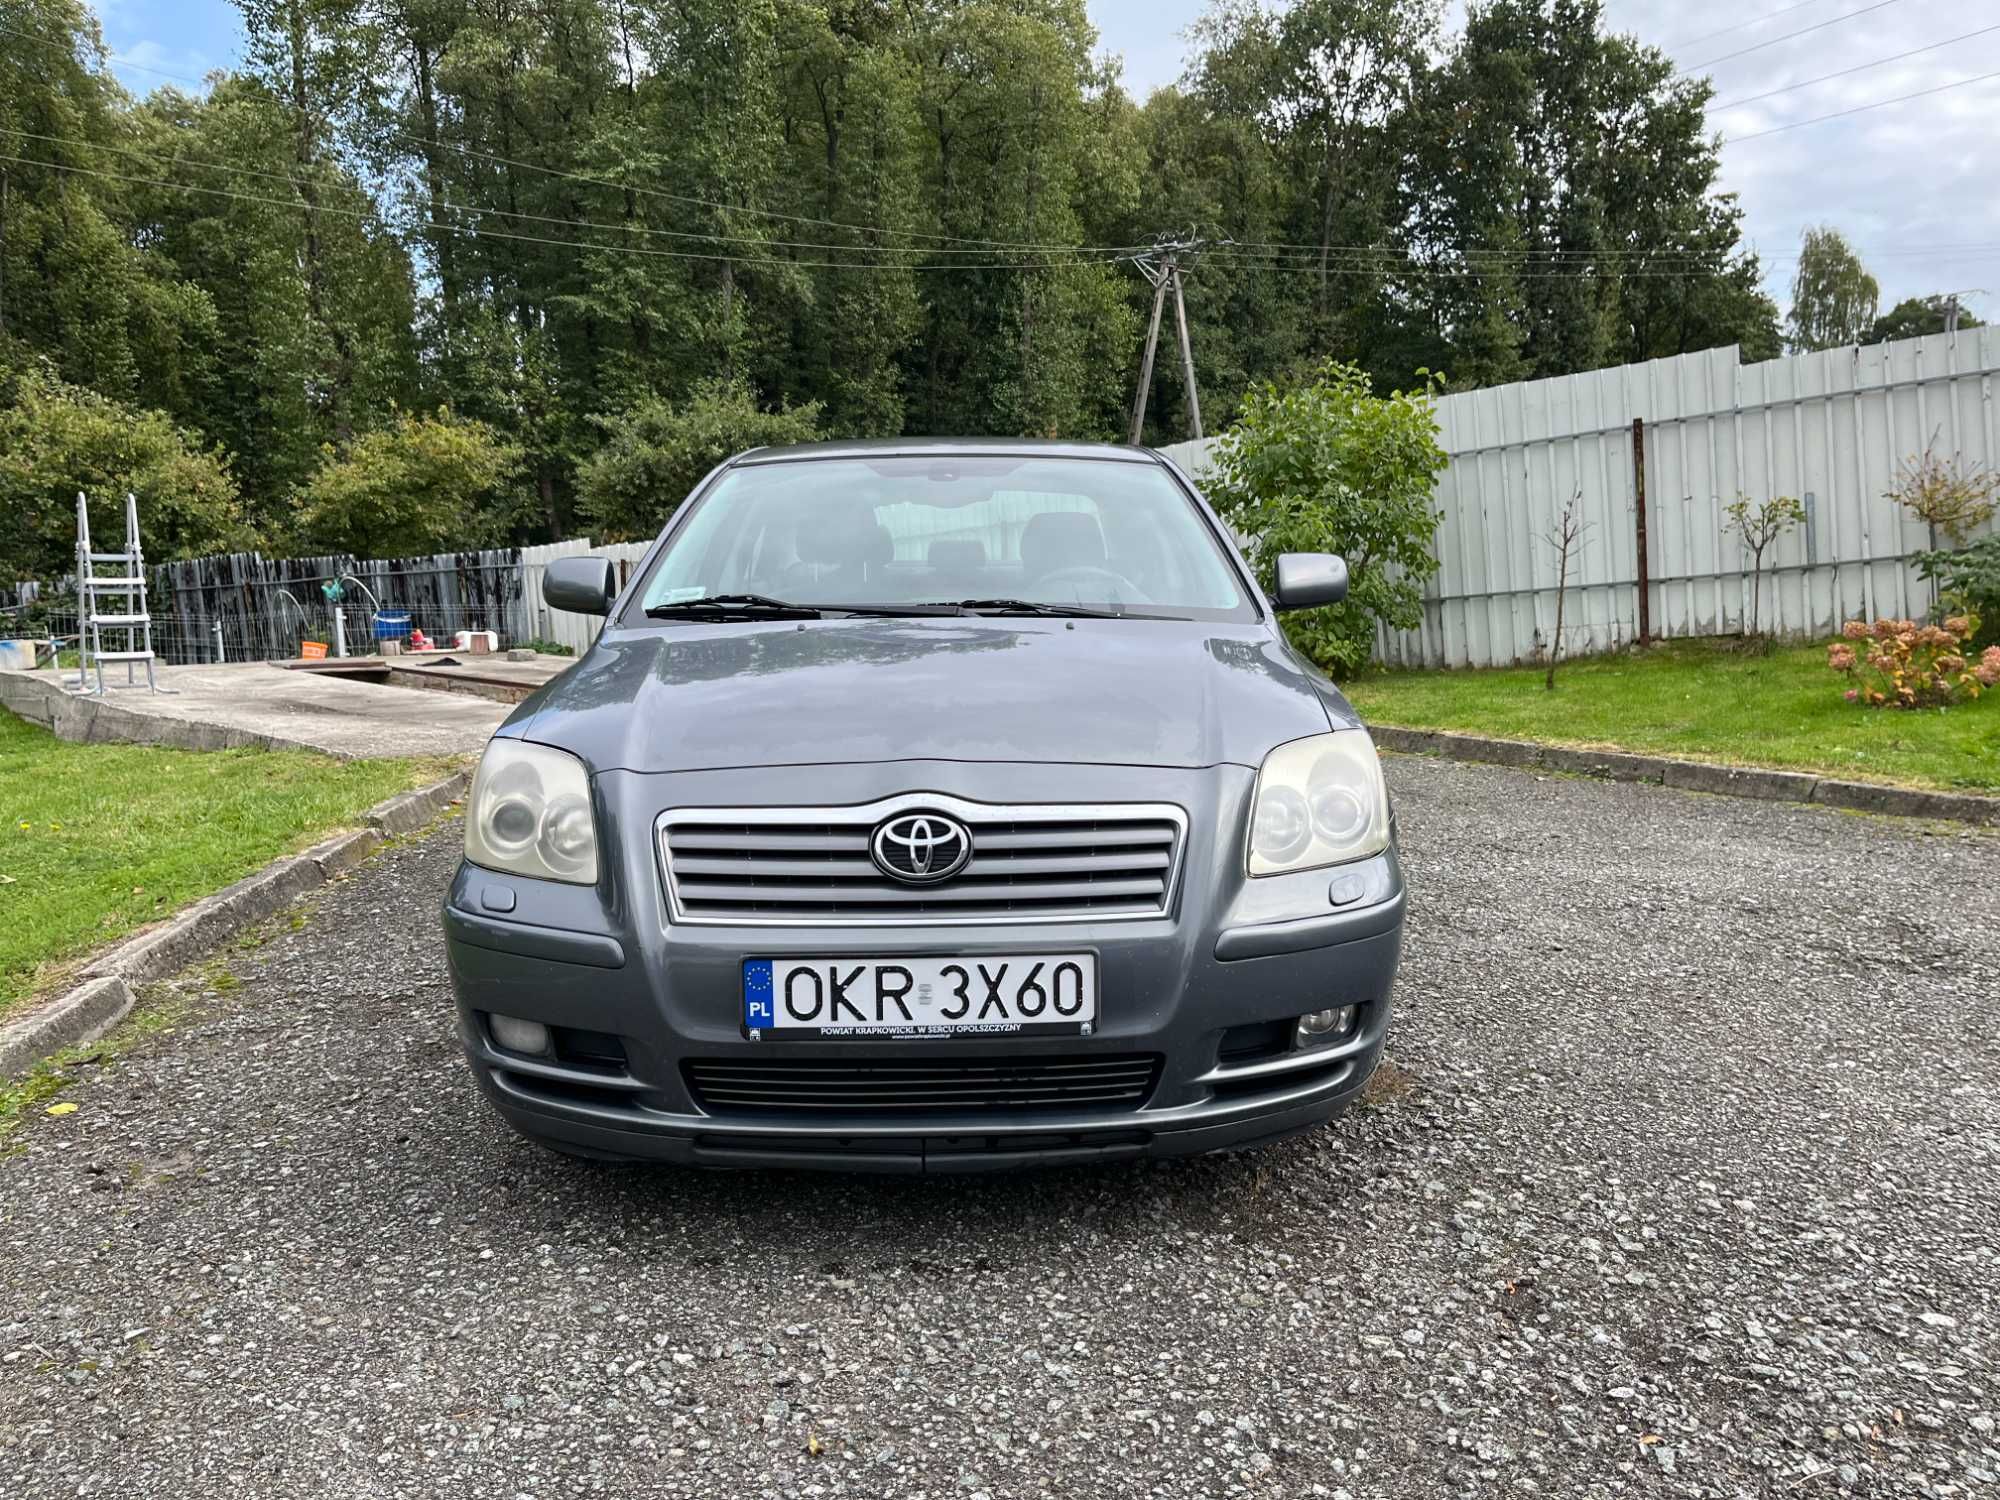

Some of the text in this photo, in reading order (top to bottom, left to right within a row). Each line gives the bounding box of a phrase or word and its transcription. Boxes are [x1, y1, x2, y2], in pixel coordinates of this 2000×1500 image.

[784, 962, 1083, 1021] OKR 3X60
[749, 1002, 770, 1017] PL
[820, 1027, 854, 1035] POWIAT
[917, 1026, 926, 1034] W
[928, 1025, 955, 1033] SERCU
[956, 1023, 1022, 1033] OPOLSZCZYZNY
